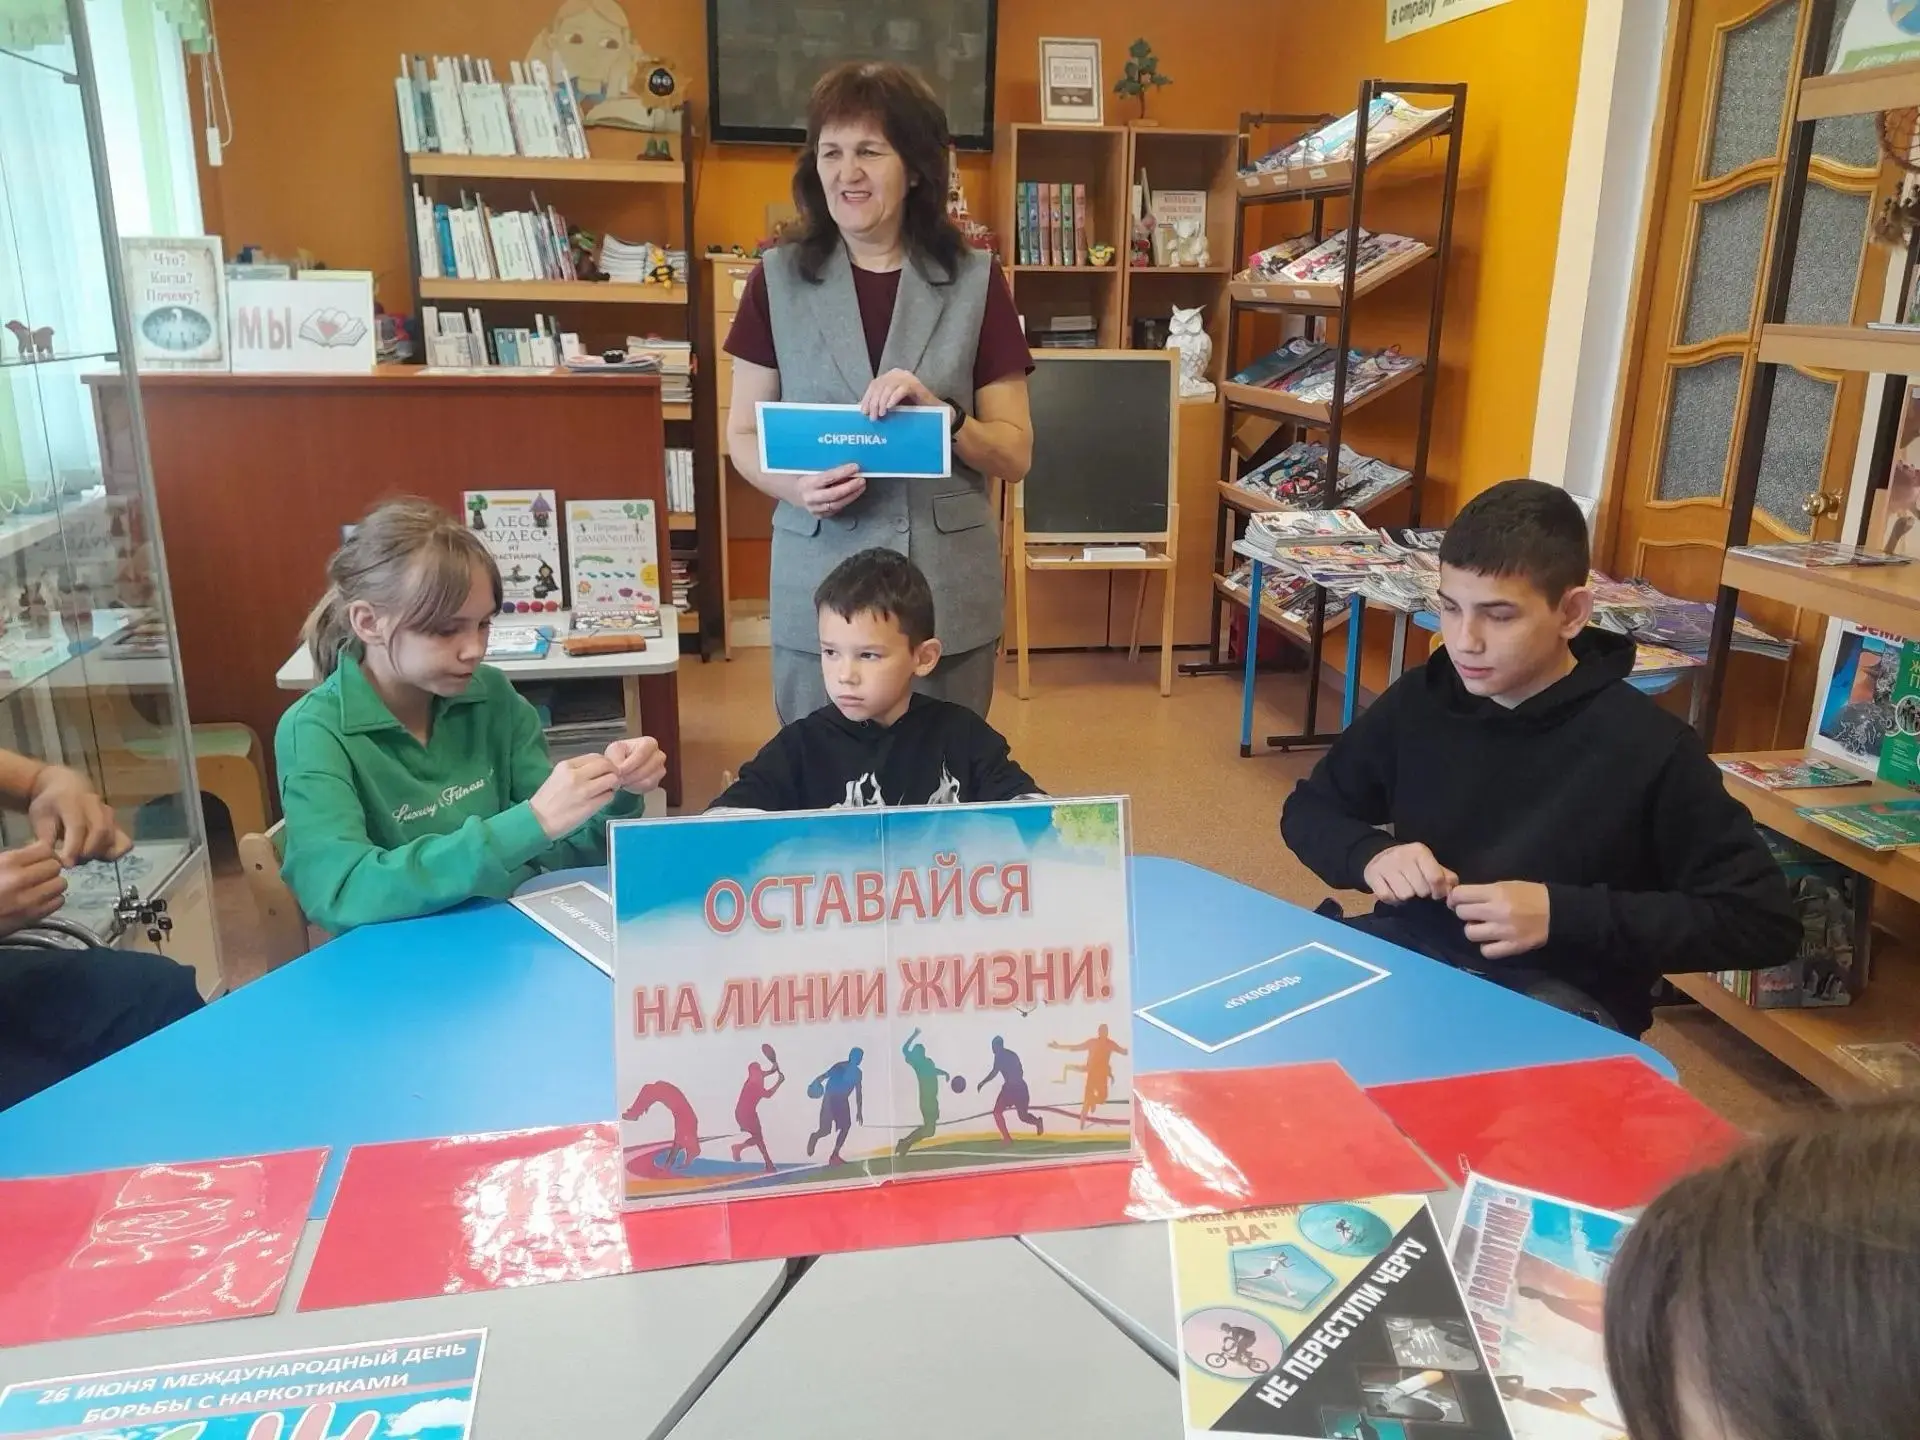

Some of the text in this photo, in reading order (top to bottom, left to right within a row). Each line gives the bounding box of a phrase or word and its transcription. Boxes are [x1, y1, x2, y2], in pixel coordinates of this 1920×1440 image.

[153, 252, 187, 268] Что?
[146, 289, 201, 305] Почему?
[150, 272, 193, 286] Когда?
[237, 306, 293, 350] МЫ
[817, 433, 888, 446] «СКРЕПКА»
[483, 529, 544, 543] ЧУДЕС
[495, 515, 530, 527] ЛЕС
[704, 851, 1032, 934] ОСТАВАЙСЯ
[633, 946, 1114, 1036] НА ЛИНИИ ЖИЗНИ!
[1224, 974, 1302, 1010] «КУКЛОВОД»
[1255, 1237, 1428, 1409] НЕ ПЕРЕСТУПИ ЧЕРТУ
[37, 1343, 468, 1406] 26 ИЮНЯ МЕЖДУНАРОДНЫЙ ДЕНЬ
[82, 1374, 410, 1425] БОРЬБЫ С НАРКОТИКАМИ
